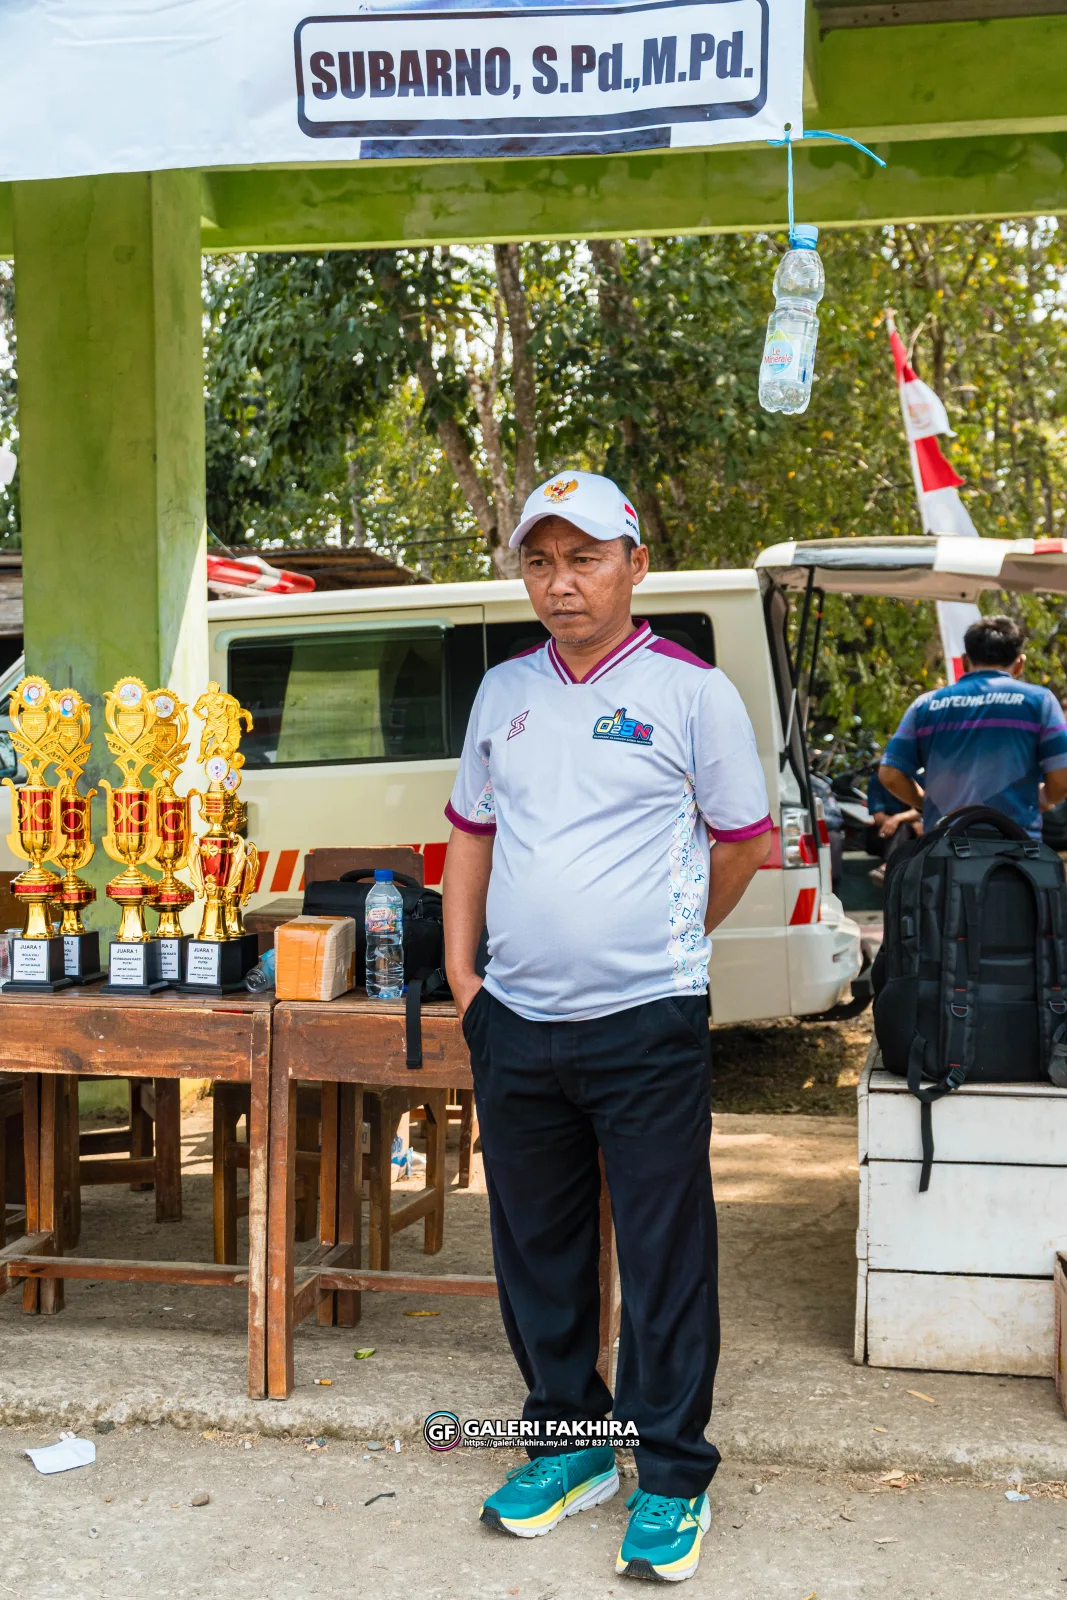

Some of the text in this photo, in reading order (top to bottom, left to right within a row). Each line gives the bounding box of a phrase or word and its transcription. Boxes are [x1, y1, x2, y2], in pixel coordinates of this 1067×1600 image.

[309, 30, 754, 101] SUBARNO, S.Pd.,M.Pd.
[773, 347, 781, 356] Le
[764, 354, 792, 364] Minerale
